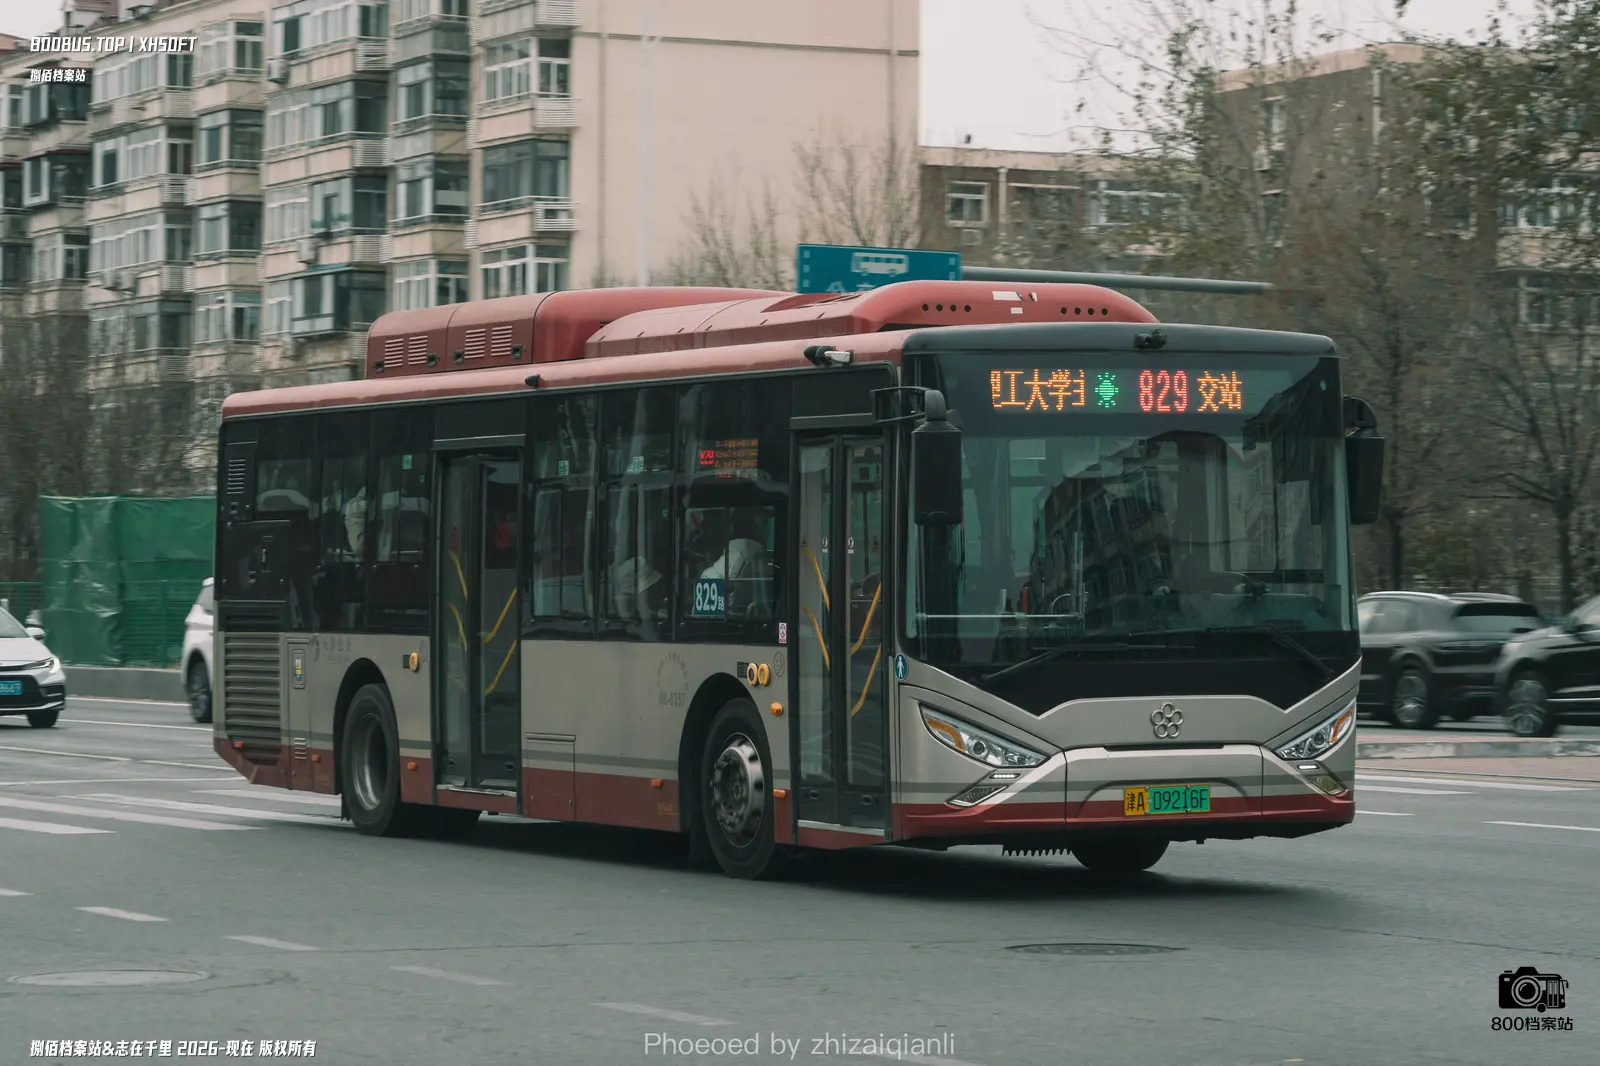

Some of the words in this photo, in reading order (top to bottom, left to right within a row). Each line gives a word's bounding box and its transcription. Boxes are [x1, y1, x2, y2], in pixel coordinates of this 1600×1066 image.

[1139, 369, 1188, 412] 829
[1196, 370, 1243, 412] 交站
[1153, 788, 1208, 811] 09216F
